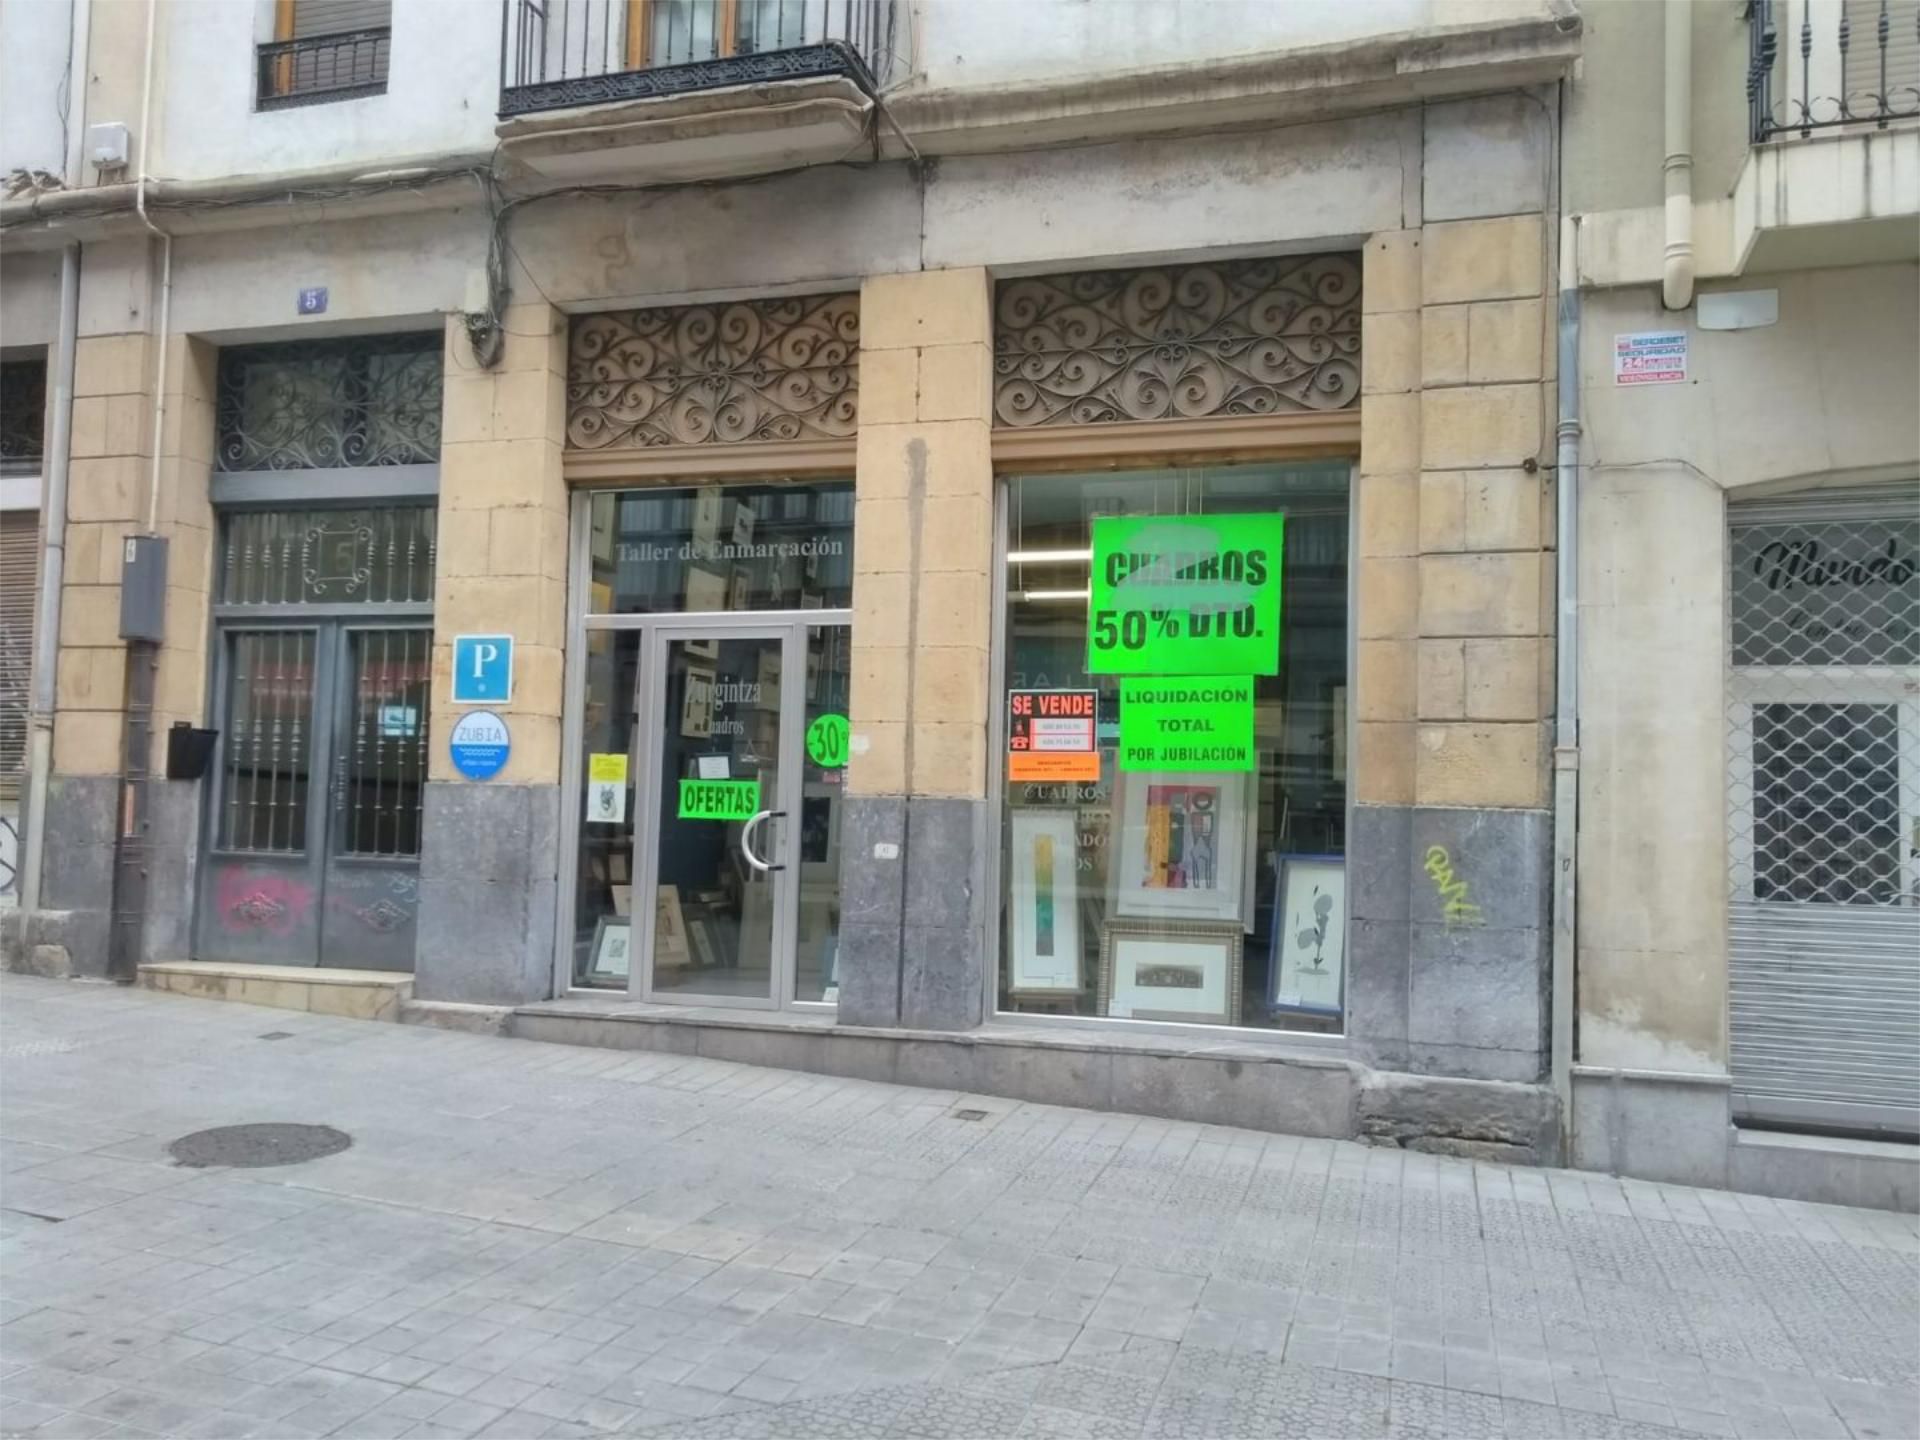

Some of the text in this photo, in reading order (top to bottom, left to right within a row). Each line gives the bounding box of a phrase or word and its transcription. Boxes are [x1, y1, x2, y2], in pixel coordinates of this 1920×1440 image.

[305, 290, 318, 310] 5
[616, 535, 843, 562] Taller de Enmarcación
[472, 643, 498, 679] P
[1125, 685, 1249, 704] LIQUIDACIÓN
[1012, 695, 1094, 715] SE VENDE
[458, 727, 502, 742] ZUBIA
[1156, 718, 1216, 733] TOTAL
[1127, 745, 1246, 761] POR JUBILACIÓN
[684, 785, 755, 814] OFERTAS
